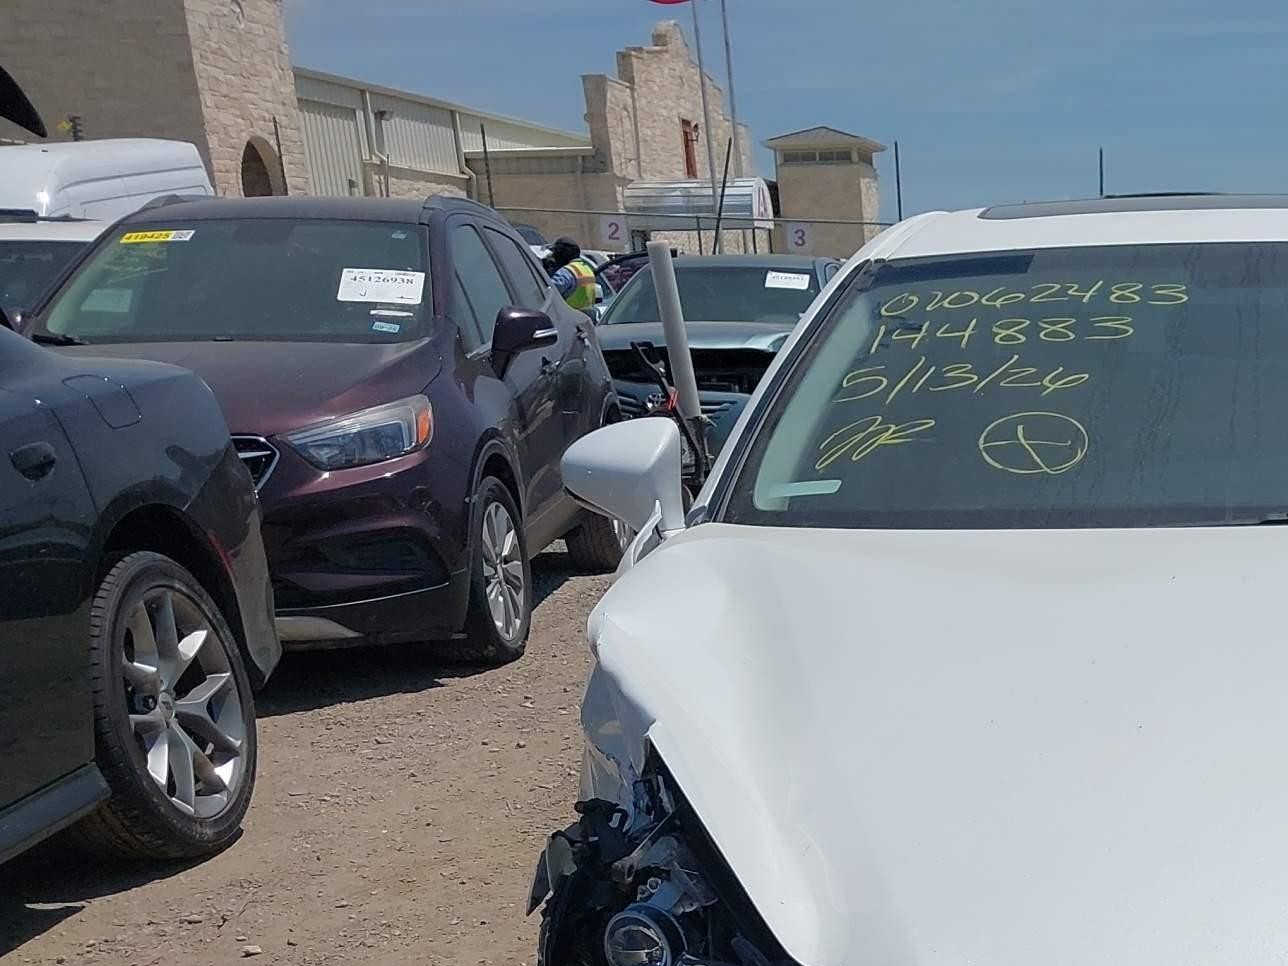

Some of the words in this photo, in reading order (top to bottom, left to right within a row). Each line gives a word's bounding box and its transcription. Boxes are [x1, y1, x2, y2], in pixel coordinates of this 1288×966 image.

[607, 222, 620, 241] 2
[794, 228, 806, 247] 3
[870, 315, 1135, 355] 144883
[832, 354, 1089, 405] 5/13/26
